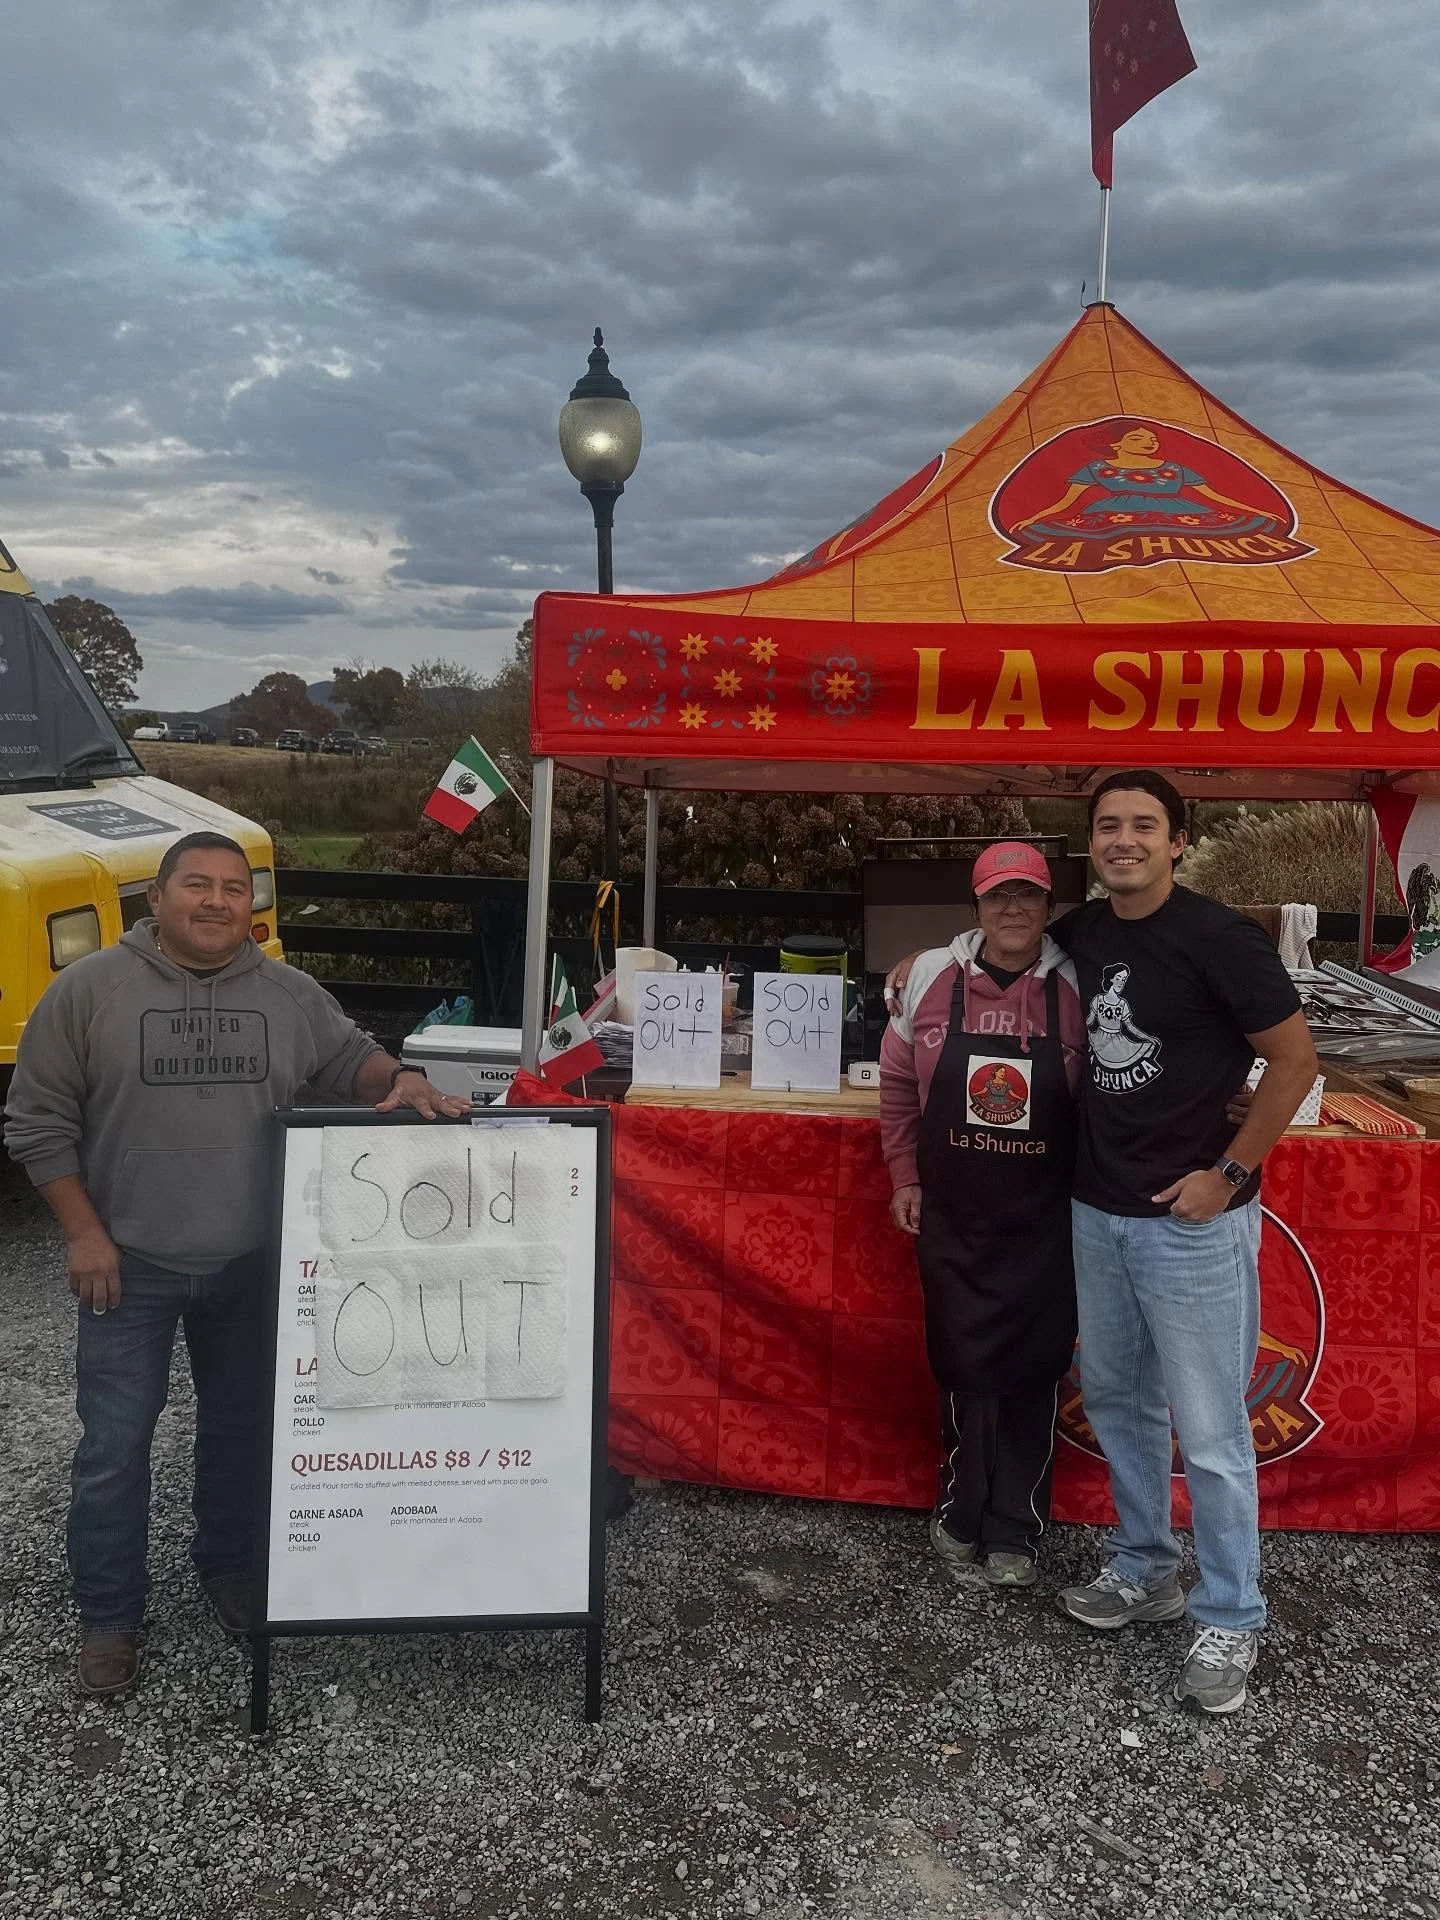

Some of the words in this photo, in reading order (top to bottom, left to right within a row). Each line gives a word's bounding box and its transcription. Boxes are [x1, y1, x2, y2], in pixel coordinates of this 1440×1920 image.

[1023, 541, 1084, 567] LA
[1102, 533, 1299, 561] SHUNCA
[909, 647, 1053, 731] LA
[1088, 647, 1440, 733] SHUNC
[645, 984, 704, 1012] Sold
[154, 1056, 257, 1075] OUTDOORS
[1093, 1060, 1158, 1090] SHUNCA
[972, 1103, 984, 1117] LA
[985, 1107, 1024, 1122] SHUNCA
[950, 1128, 969, 1147] La
[974, 1132, 1046, 1154] Shunca
[351, 1147, 516, 1242] Sold
[296, 1357, 318, 1376] LA
[293, 1394, 316, 1405] CAR
[293, 1417, 325, 1427] POLLO
[292, 1429, 321, 1437] chicken
[291, 1450, 437, 1478] QUESADILLAS
[445, 1449, 471, 1471] $8
[498, 1448, 531, 1470] $12
[289, 1509, 326, 1520] CARNE
[328, 1508, 364, 1518] ASADA
[390, 1505, 438, 1516] ADOBADA
[288, 1533, 321, 1542] POLLO
[287, 1544, 317, 1552] chicken
